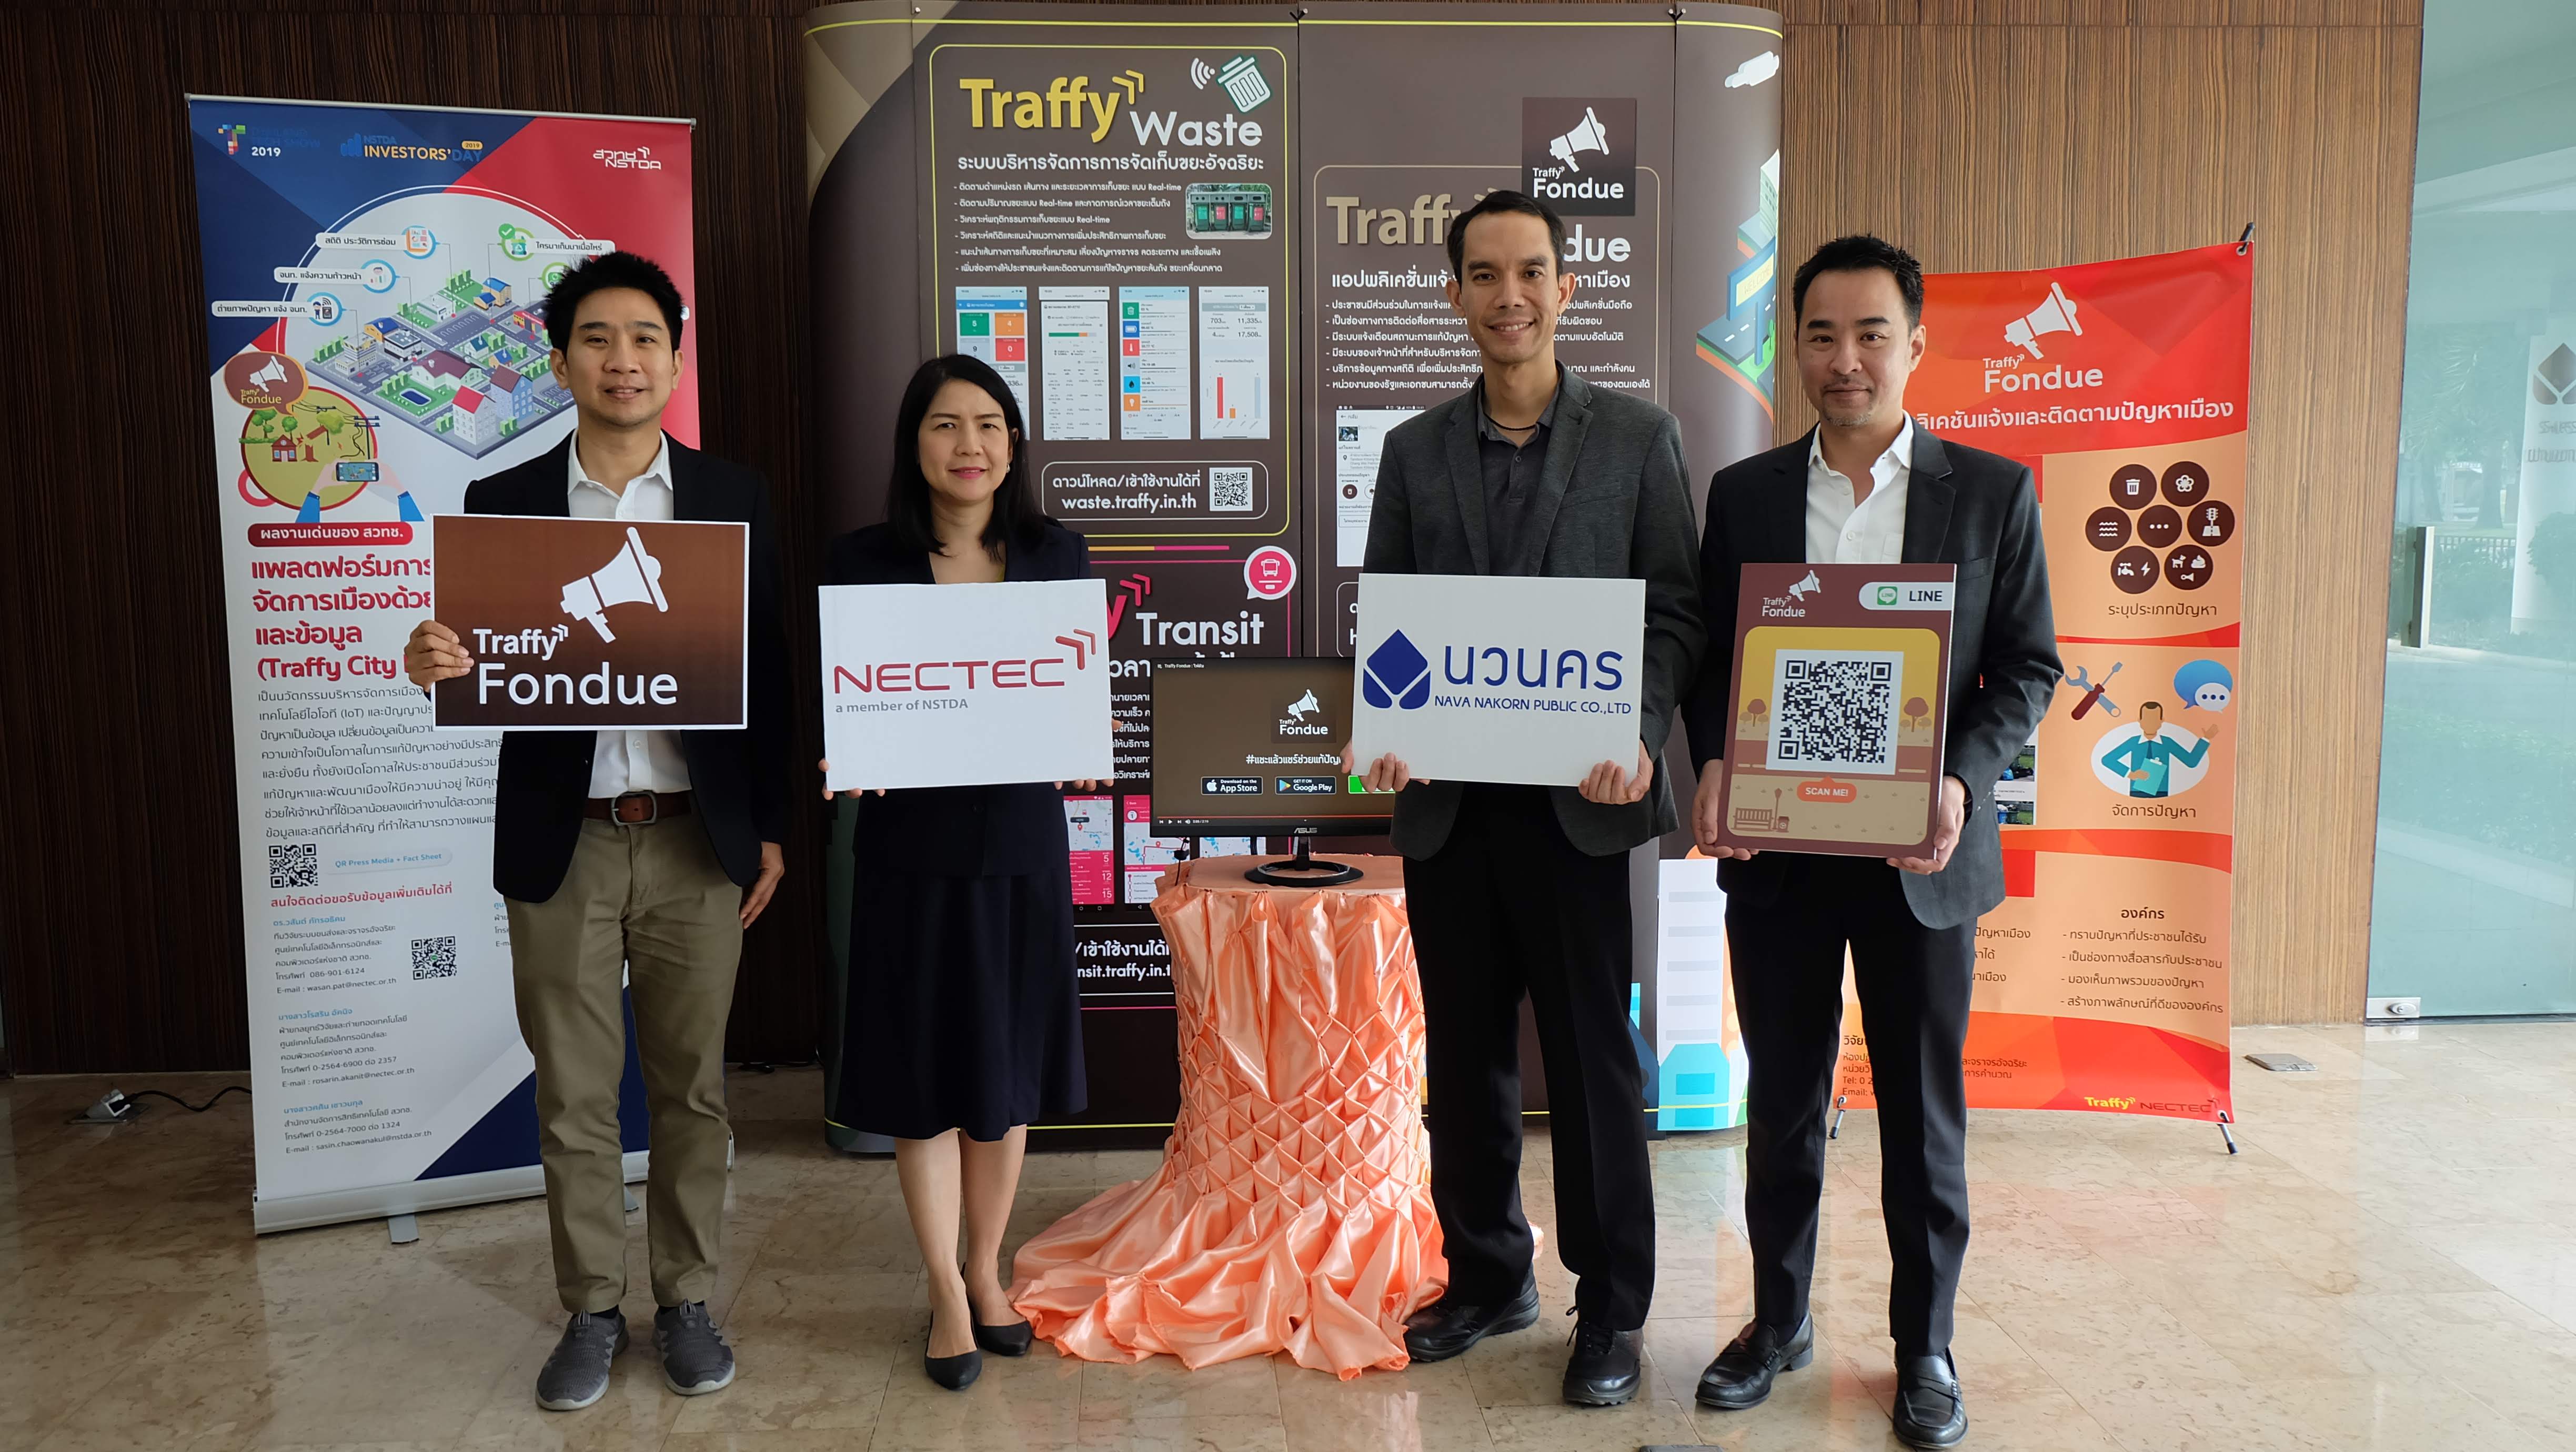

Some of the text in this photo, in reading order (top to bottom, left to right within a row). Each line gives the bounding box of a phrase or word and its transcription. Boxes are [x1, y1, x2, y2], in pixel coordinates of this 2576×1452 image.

[960, 76, 1120, 143] Traffy
[1129, 110, 1263, 147] Waste
[364, 135, 397, 144] NSTDA
[251, 147, 280, 157] 2019
[452, 149, 482, 162] DAY
[605, 159, 661, 169] NSTDA
[958, 150, 1264, 171] ระบบบริหารจัดการการจัดเก็บขยะอัจฉริยะ
[1533, 167, 1560, 179] Traffy
[1533, 178, 1624, 199] Fondue
[1326, 194, 1462, 245] Traff
[344, 237, 396, 245] ประวัติการซ่อม
[300, 270, 361, 280] แจ้งความก้าวหน้า
[217, 304, 270, 314] ถ่ายภาพปัญหา
[274, 303, 287, 312] แจ้ง
[1983, 357, 2020, 370] Traffy
[1985, 365, 2103, 394] Fondue
[240, 395, 282, 404] Fondue
[1052, 470, 1200, 488] ดาวน์โหลด/เข้าใช้งานได้ที่
[1061, 492, 1196, 513] waste.traffy.in.th
[260, 525, 404, 539] ผลงานเด่นของ สวทช.
[1763, 597, 1787, 607] Traffy
[1909, 590, 1943, 602] LINE
[1762, 606, 1806, 618] Fondue
[2108, 603, 2217, 618] ระบุประเภทปัญหา
[256, 620, 362, 651] และข้อมูล
[1135, 610, 1264, 646] Transit
[473, 628, 558, 660] Traffy
[258, 657, 340, 681] (Traffy
[347, 656, 396, 679] City
[834, 658, 1065, 694] NECTEC
[1444, 646, 1623, 691] นวนคร
[479, 661, 678, 705] Fondue
[836, 699, 969, 713] a member of NSTDA
[1435, 695, 1631, 714] NAVA NAKORN PUBLIC CO.,LTD
[259, 707, 337, 721] เทคโนโลยีไอโอที
[340, 709, 364, 719] (IoT)
[260, 728, 336, 741] ปัญหาเป็นข้อมูล
[1279, 724, 1328, 734] Fondue
[1246, 753, 1341, 765] #แชะแล้วแชร์ช่วยแก้ปัญ
[263, 766, 309, 779] และยั่งยืน
[1220, 784, 1236, 793] App
[1293, 784, 1332, 793] Google Play
[1805, 788, 1848, 797] SCAN ME!
[2112, 804, 2197, 819] จัดการปัญหา
[335, 860, 347, 869] QR
[421, 853, 442, 861] Sheet
[270, 882, 453, 908] สนใจติดต่อขอรับข้อมูลเพิ่มเติมได้ที่
[2121, 906, 2165, 920] องค์กร
[2070, 929, 2207, 944] ทราบปัญหาที่ประชาชนได้รับ
[2069, 950, 2222, 969] เป็นช่องทางสื่อสารกับประชาชน
[309, 967, 365, 978] 086-901-6124
[277, 978, 397, 994] E-mail wasan.pat@nectec.or.th
[2068, 973, 2204, 989] มองเห็นภาพรวมของปัญหา
[2067, 995, 2223, 1013] สร้างภาพลักษณ์ที่ดีขององค์กร
[313, 1060, 363, 1071] 0-2564-6900
[312, 1067, 415, 1084] rosarin.akanit@nectec.or.th
[1843, 1087, 1867, 1096] Email:
[2084, 1097, 2211, 1113] Traffy NECTEC
[316, 1125, 367, 1137] 0-2564-7000
[381, 1121, 400, 1130] 1324
[286, 1130, 432, 1154] E-mail sasin.chaowanakul@nstda.or.th
